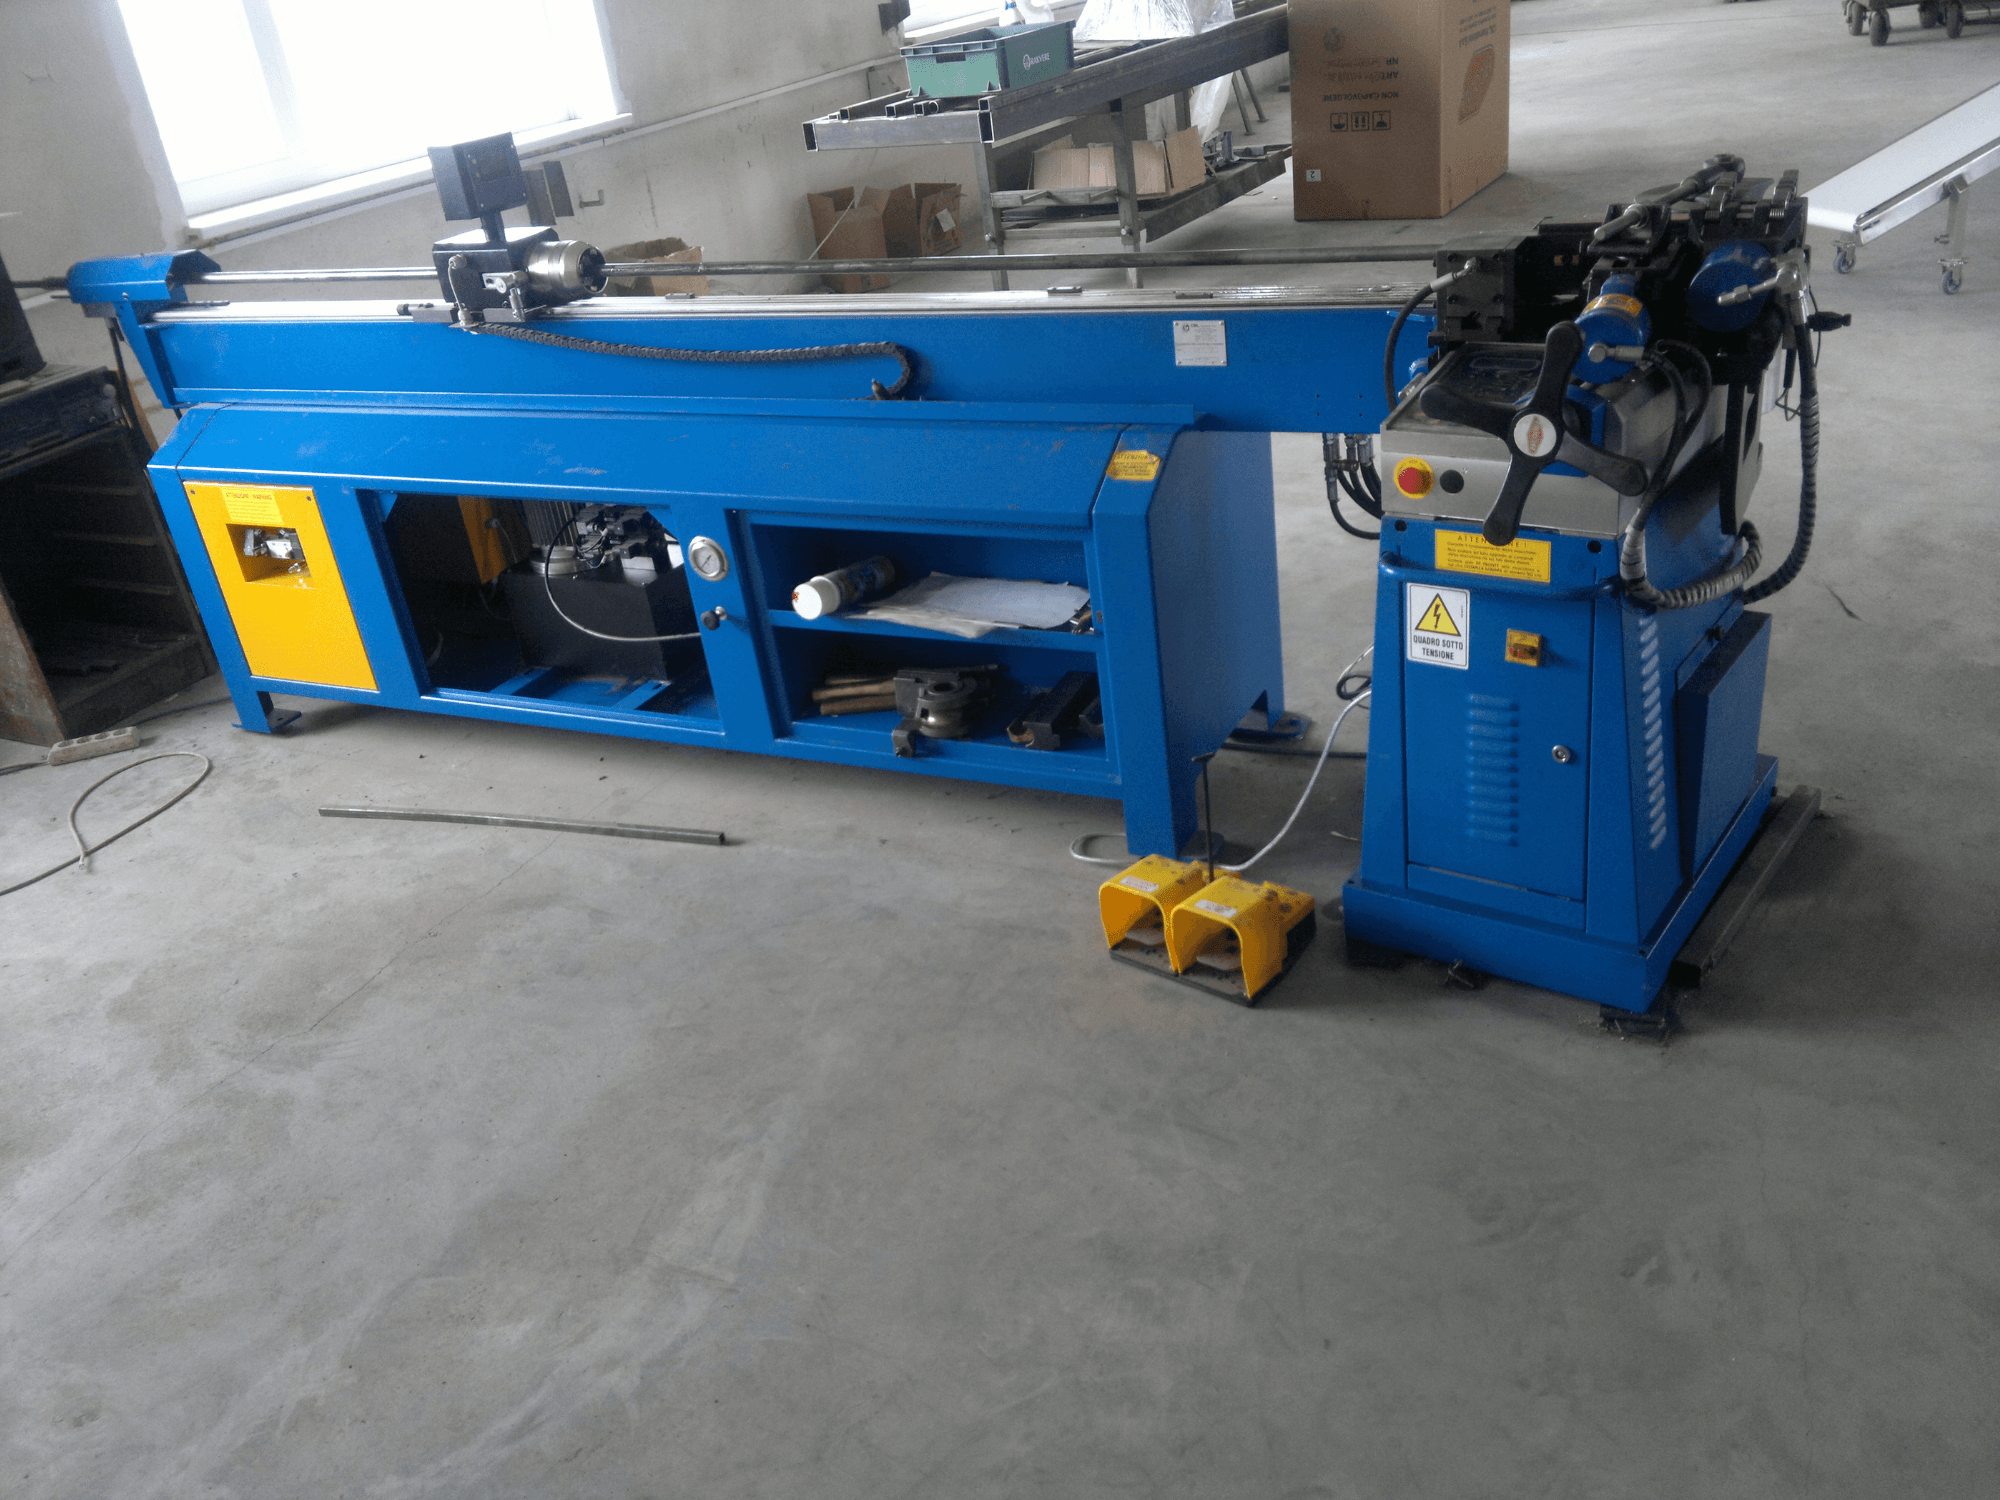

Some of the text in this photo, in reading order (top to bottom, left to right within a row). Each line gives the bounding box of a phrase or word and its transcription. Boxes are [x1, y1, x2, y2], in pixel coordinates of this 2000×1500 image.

[1030, 52, 1050, 65] RAKVERE
[1413, 635, 1464, 650] QUADRO SOTTO
[1422, 647, 1454, 660] TENSIONE
